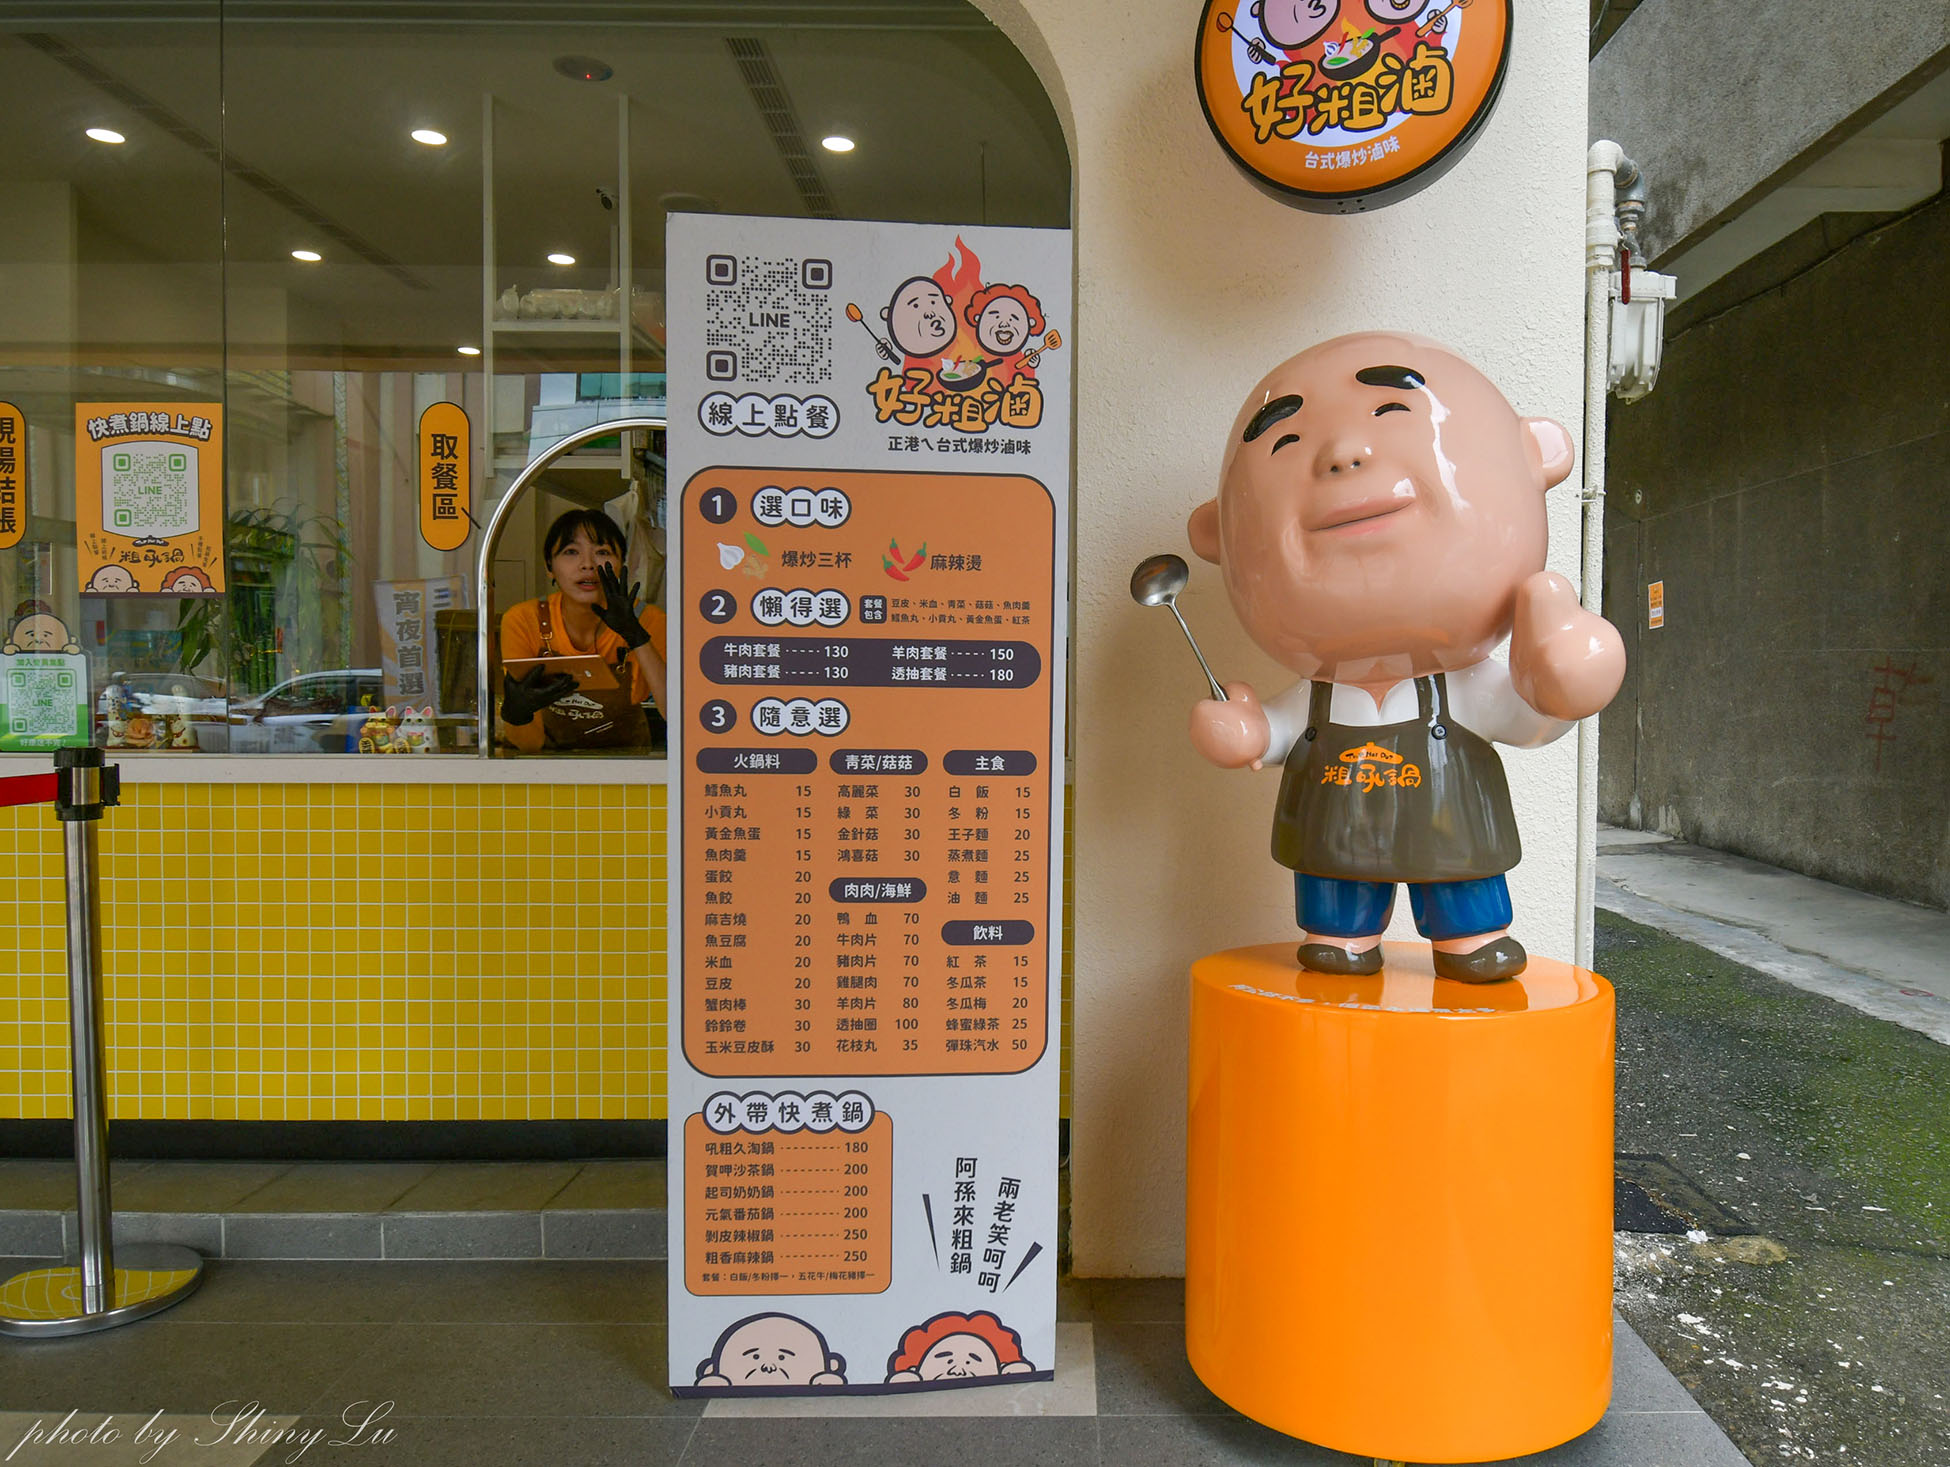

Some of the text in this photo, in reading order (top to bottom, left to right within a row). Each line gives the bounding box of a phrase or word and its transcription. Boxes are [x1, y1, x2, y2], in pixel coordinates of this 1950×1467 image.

[1241, 41, 1454, 144] 好粗滷
[1304, 136, 1400, 170] 台式爆炒滷味
[749, 312, 790, 329] LINE
[867, 367, 1043, 432] 好粗滷
[708, 402, 830, 430] 線上點餐
[87, 411, 212, 442] 快煮鍋線上點
[430, 433, 459, 520] 取餐區
[138, 485, 162, 495] LINE
[712, 494, 843, 520] 1 選口味
[781, 550, 852, 569] 爆炒三杯
[930, 553, 983, 571] 麻辣燙
[711, 595, 842, 619] 2 懶得選
[864, 610, 883, 620] 包含
[393, 590, 424, 697] 宵夜首選
[724, 643, 849, 659] 牛肉套餐 130
[892, 645, 1014, 661] 羊肉套餐 150
[724, 663, 849, 680] 豬肉套餐 130
[891, 666, 1014, 681] 透抽套餐 180
[32, 698, 53, 707] LINE
[711, 706, 842, 728] 3 隨意選
[734, 753, 780, 769] 火鍋料
[845, 754, 913, 771] 青菜/菇菇
[975, 755, 1005, 771] 主食
[705, 784, 811, 797] 鱈魚丸 15
[837, 785, 919, 798] 高麗菜 30
[1016, 787, 1030, 798] 15
[705, 805, 811, 819] 小貢丸 15
[904, 808, 919, 819] 30
[1016, 808, 1030, 819] 15
[705, 827, 811, 841] 黃金魚蛋 15
[837, 827, 919, 841] 金針菇 30
[948, 828, 1030, 841] 王子麵 20
[705, 848, 811, 862] 魚肉羹 15
[837, 849, 919, 862] 鴻喜菇 30
[948, 849, 1030, 862] 蒸煮麵 25
[705, 870, 811, 883] 蛋餃 20
[1014, 871, 1030, 882] 25
[705, 891, 811, 905] 魚餃 20
[844, 883, 912, 899] 肉肉/海鮮
[1014, 892, 1030, 903] 25
[705, 912, 811, 926] 麻吉燒 20
[904, 913, 919, 924] 70
[973, 925, 1003, 941] 飲料
[705, 934, 811, 947] 魚豆腐 20
[837, 934, 919, 947] 牛肉片 70
[705, 955, 811, 969] 米血 20
[837, 955, 919, 968] 豬肉片 70
[1013, 956, 1028, 967] 15
[705, 977, 811, 990] 豆皮 20
[837, 976, 919, 989] 雞腿肉 70
[946, 976, 1028, 989] 冬瓜茶 15
[705, 998, 811, 1012] 蟹肉棒 30
[837, 997, 919, 1010] 羊肉片 80
[946, 997, 1028, 1010] 冬瓜梅 20
[705, 1019, 811, 1033] 鈴鈴卷 30
[837, 1018, 919, 1031] 透抽圈 100
[946, 1017, 1028, 1031] 蜂蜜綠茶 25
[705, 1040, 811, 1054] 玉米豆皮酥 30
[837, 1039, 919, 1053] 花枝丸 35
[946, 1038, 1028, 1052] 彈珠汽水 50
[714, 1101, 864, 1124] 外帶快煮鍋
[844, 1142, 868, 1153] 180
[705, 1164, 868, 1178] 賀呷沙茶鍋 200
[705, 1185, 868, 1199] 起司奶奶鍋 200
[705, 1207, 868, 1221] 元氣番茄鍋 200
[950, 1157, 978, 1274] 阿孫來粗鍋
[705, 1228, 868, 1243] 剝皮辣椒鍋 250
[978, 1176, 1021, 1293] 兩老笑呵呵
[705, 1250, 868, 1265] 粗香麻辣鍋 250
